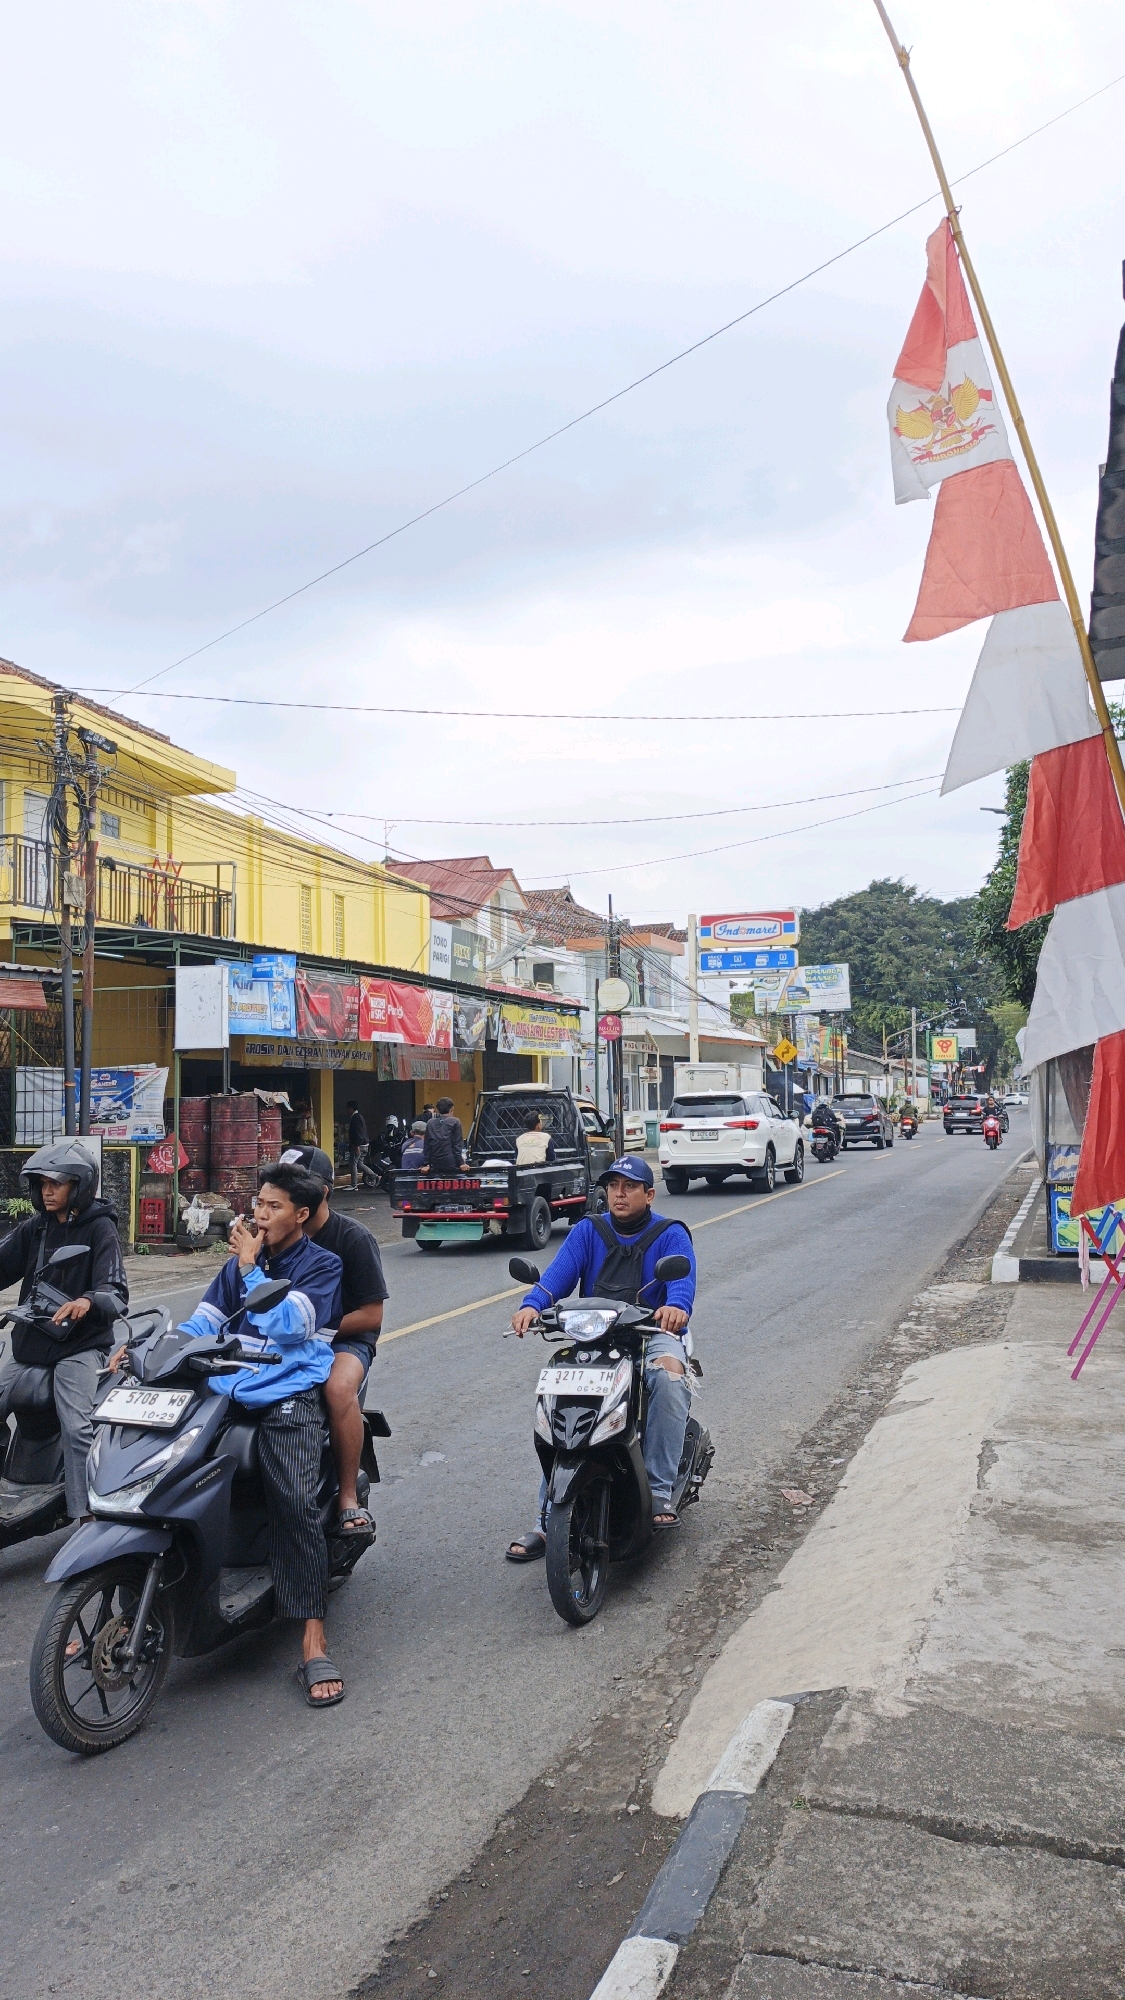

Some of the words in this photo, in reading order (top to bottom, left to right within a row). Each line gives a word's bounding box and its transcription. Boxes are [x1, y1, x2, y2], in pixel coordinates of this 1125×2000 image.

[929, 440, 980, 462] INDONESIA
[716, 924, 777, 936] Indomaret
[433, 935, 448, 948] TOKO
[433, 951, 450, 964] PARIGI
[277, 1044, 293, 1056] DAN
[540, 1371, 548, 1381] Z
[555, 1371, 585, 1381] 3217
[600, 1371, 614, 1382] TH
[107, 1390, 120, 1403] Z
[125, 1391, 160, 1406] 5708
[195, 1468, 221, 1489] HONDA
